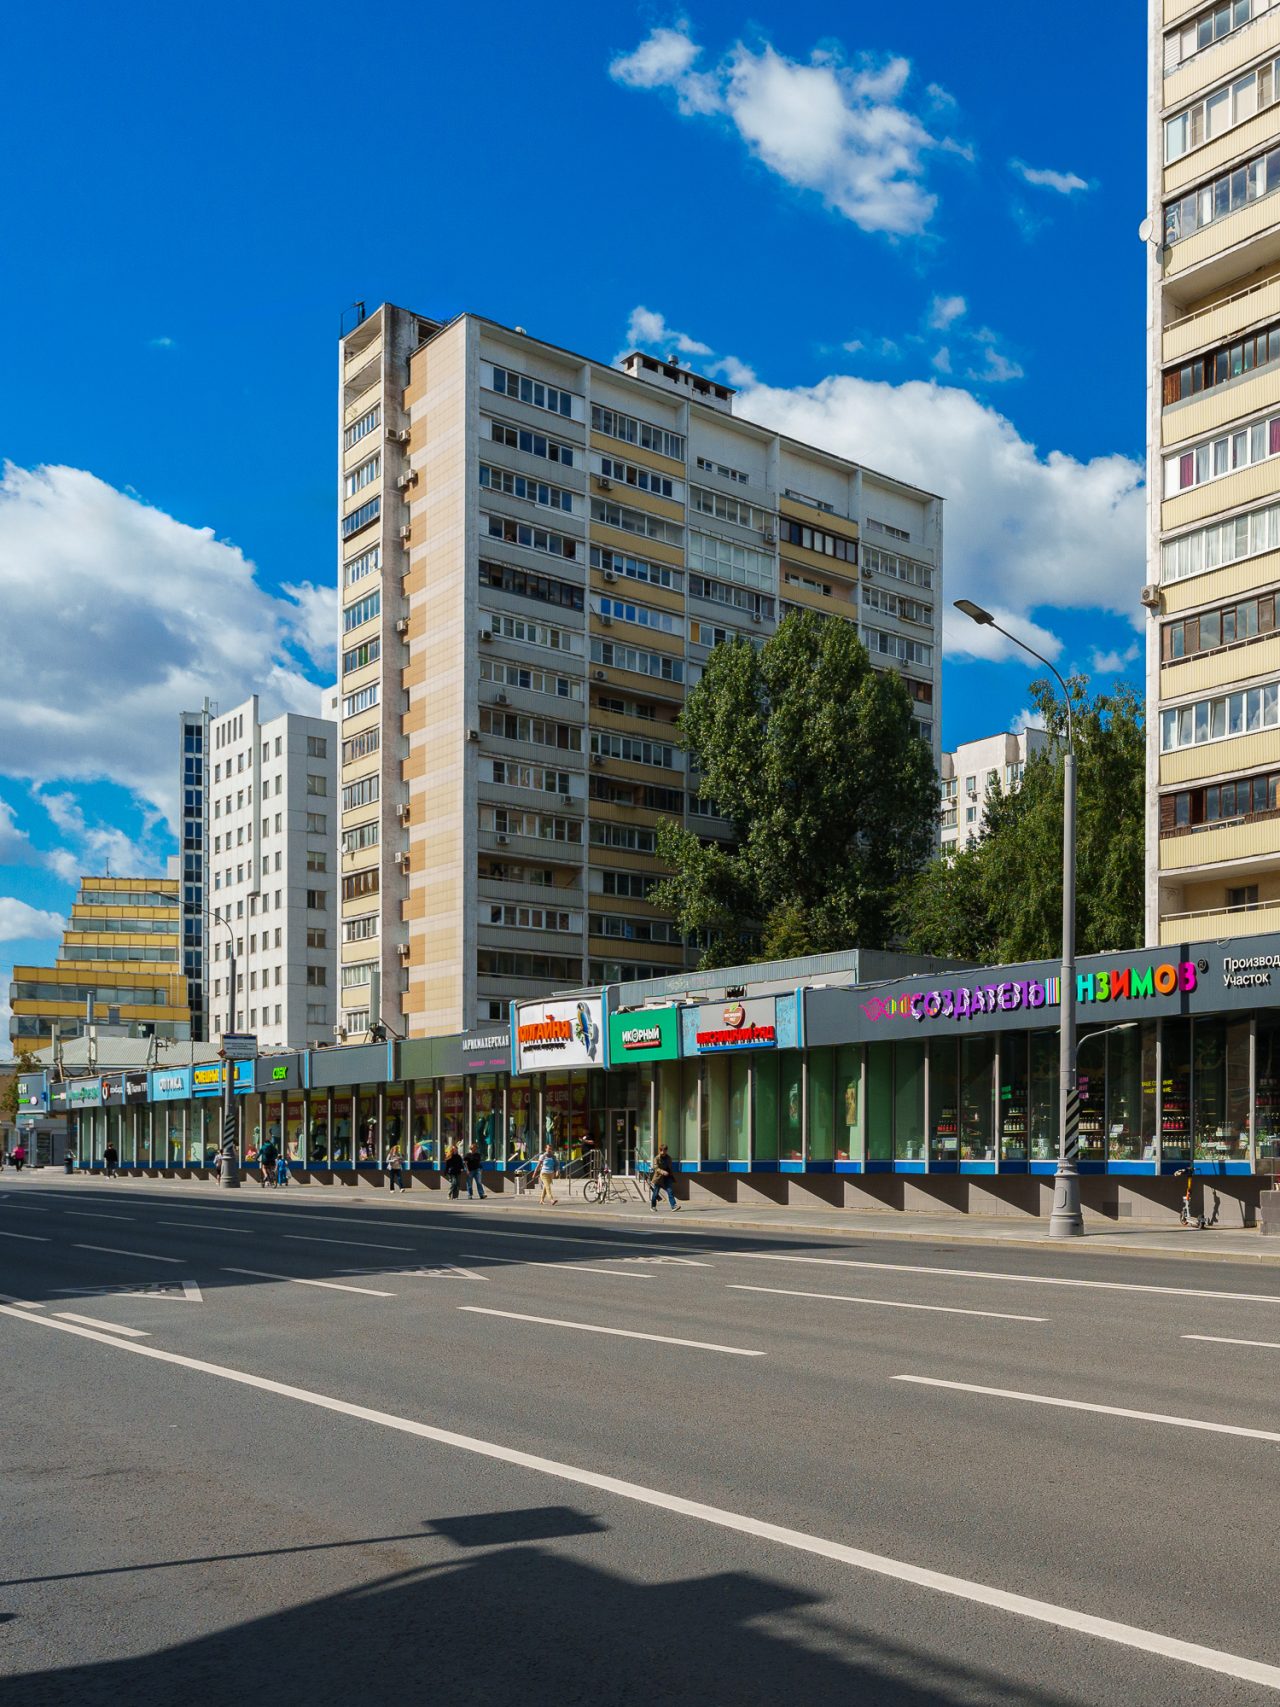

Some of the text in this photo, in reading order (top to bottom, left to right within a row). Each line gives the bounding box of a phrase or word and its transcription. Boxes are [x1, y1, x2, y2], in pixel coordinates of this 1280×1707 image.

[1223, 973, 1269, 986] Участок
[911, 962, 1197, 1020] СОЗДАТЕЛЬ НЗИМОВ
[622, 1025, 659, 1042] ИКОРНЫЙ
